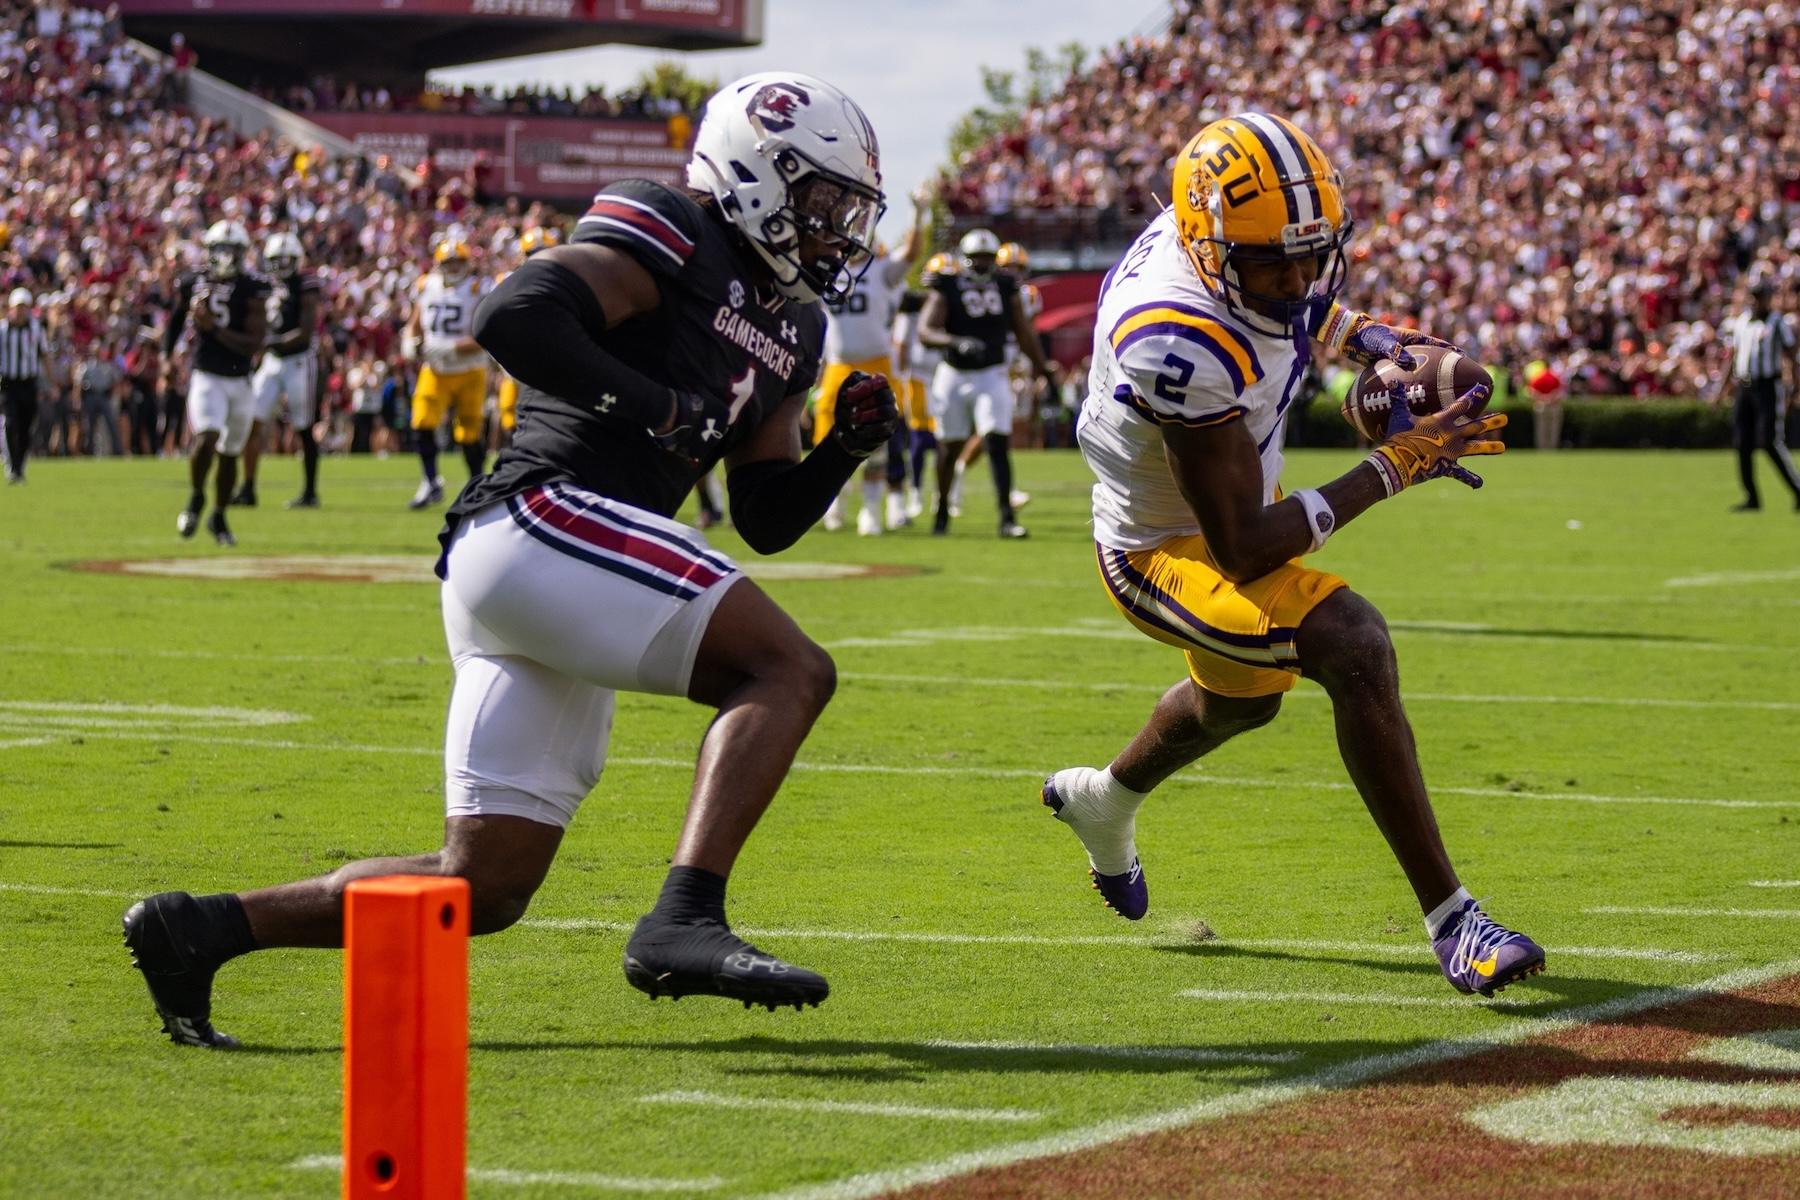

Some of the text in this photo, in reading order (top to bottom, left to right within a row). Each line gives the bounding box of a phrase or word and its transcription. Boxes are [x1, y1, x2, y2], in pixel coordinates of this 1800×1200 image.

[1189, 133, 1260, 209] LSU
[1295, 224, 1321, 237] LSU
[428, 304, 464, 334] 72
[713, 305, 796, 381] GAMECOCKS
[727, 366, 756, 426] 1
[1155, 352, 1195, 405] 2
